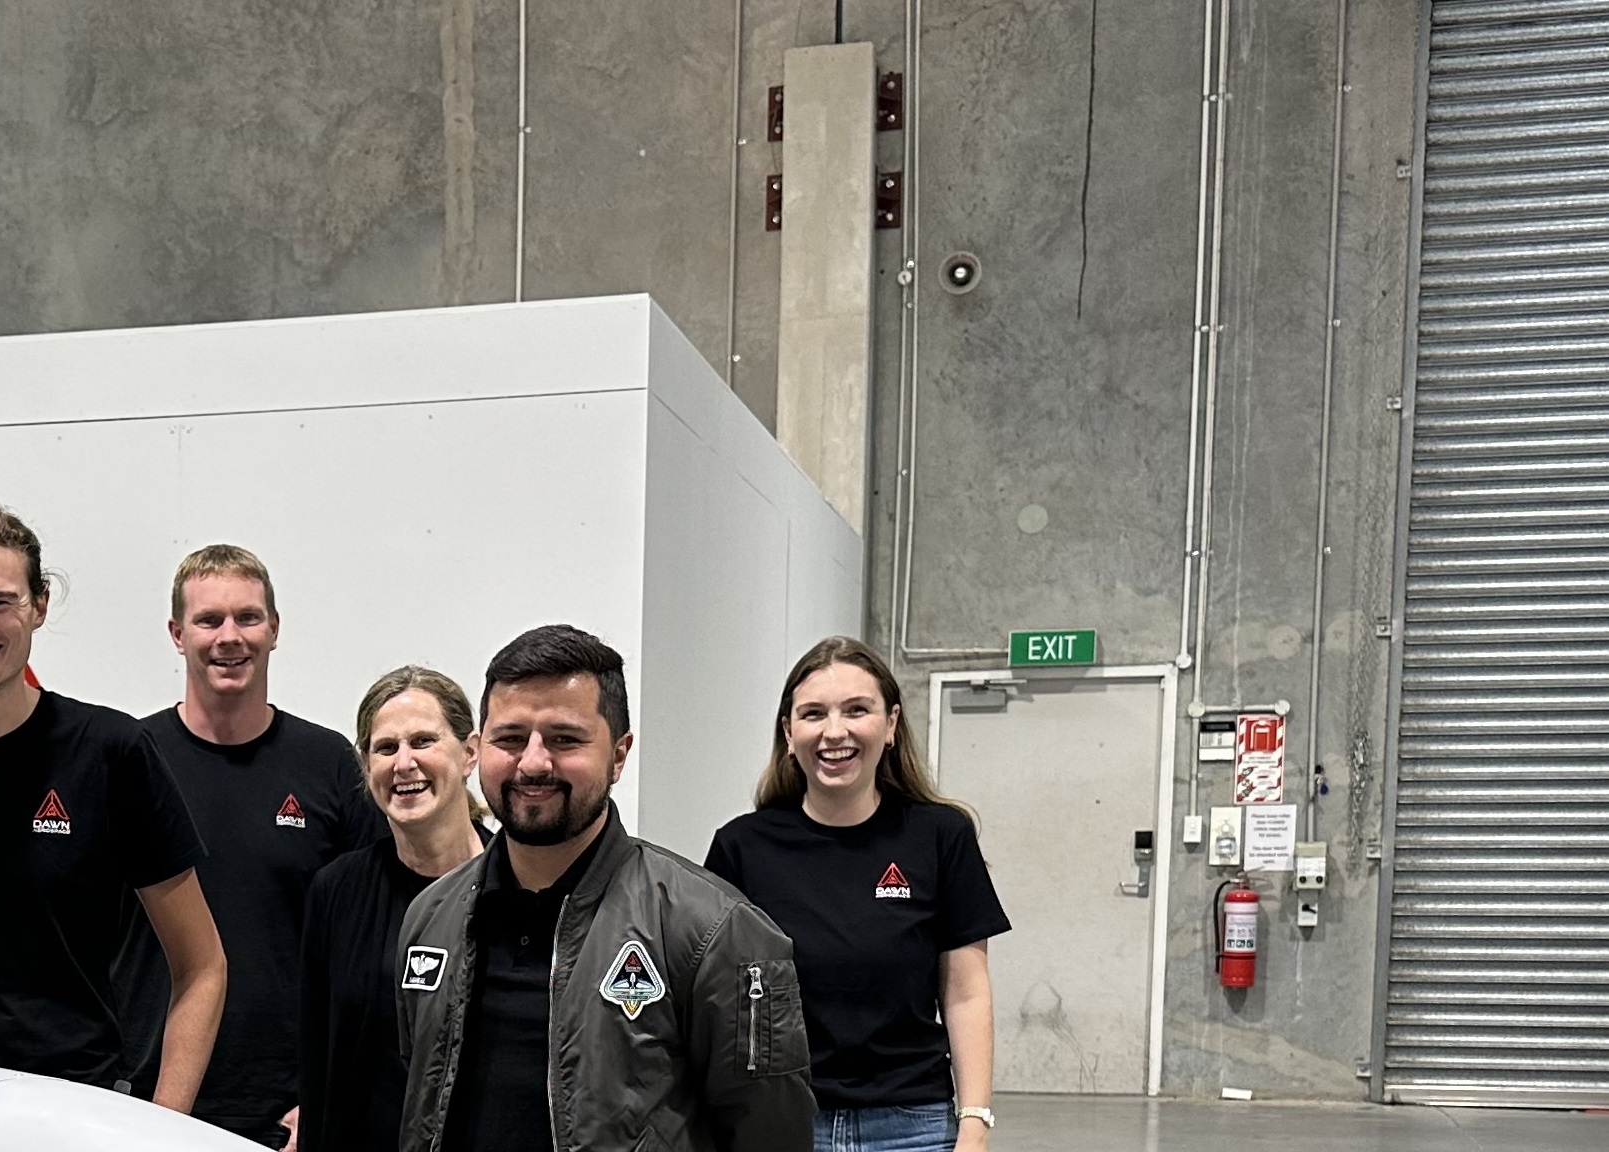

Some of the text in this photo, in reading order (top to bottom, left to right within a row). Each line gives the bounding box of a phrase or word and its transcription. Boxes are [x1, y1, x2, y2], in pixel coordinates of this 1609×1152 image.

[1028, 635, 1077, 660] EXIT
[33, 820, 70, 830] DAWN
[876, 887, 910, 896] DAWN
